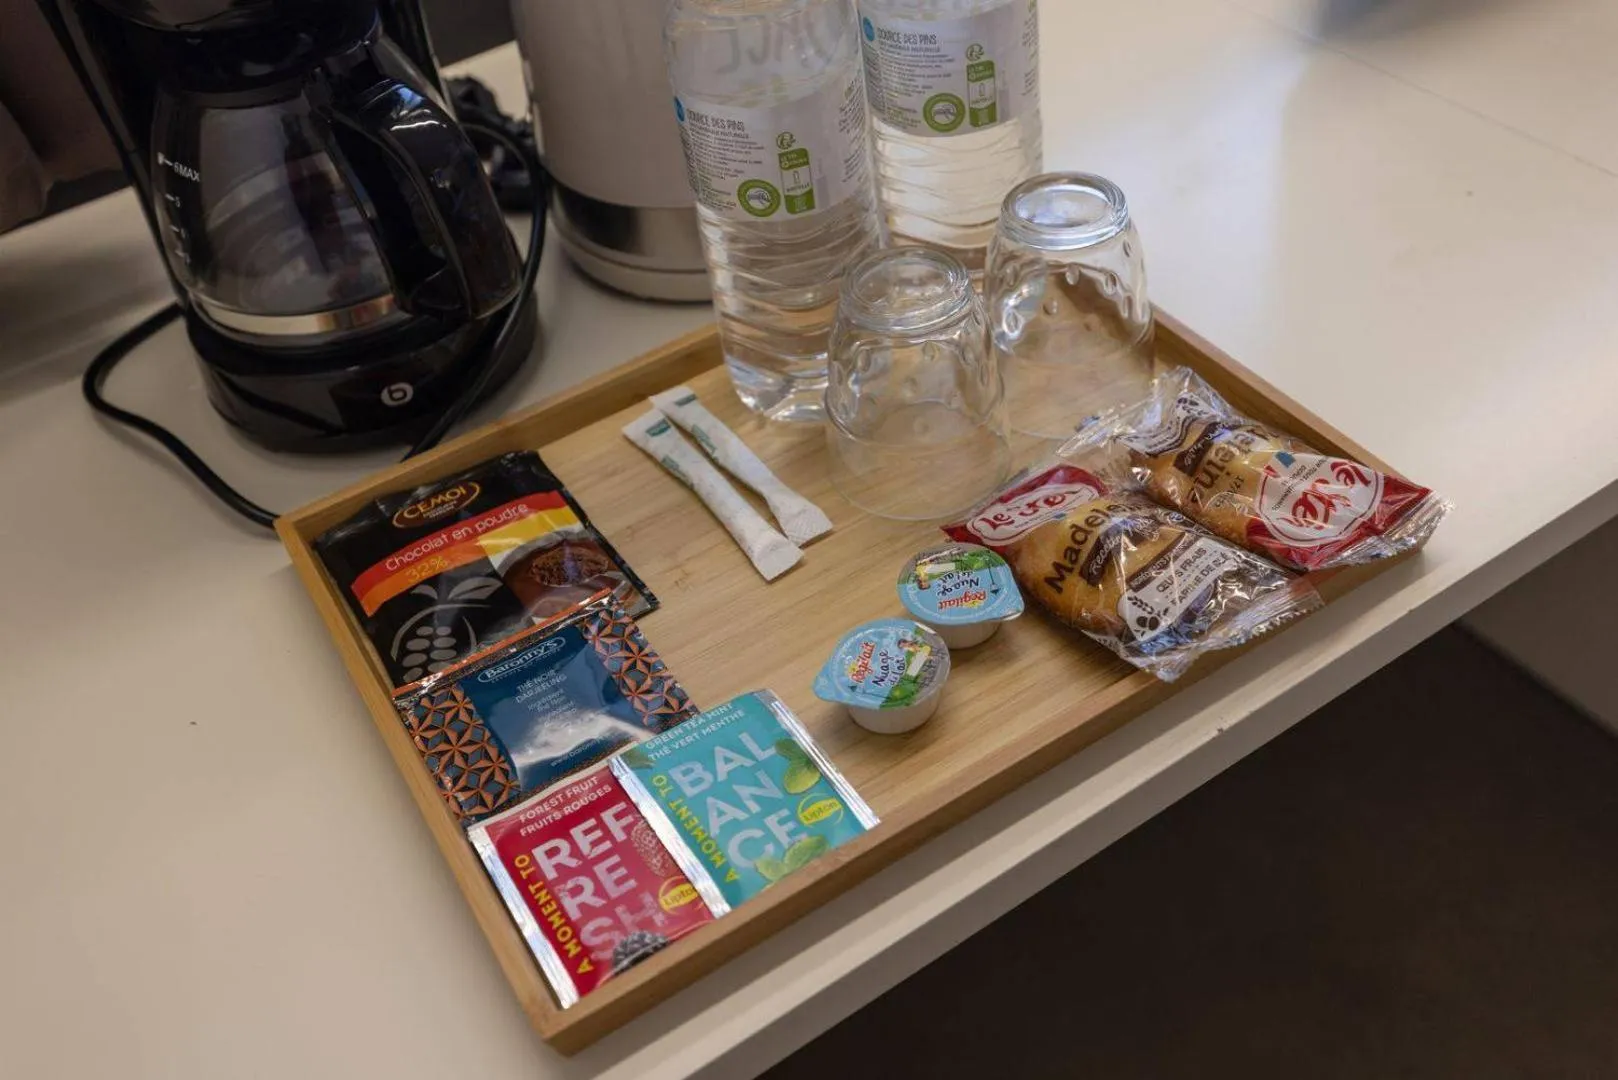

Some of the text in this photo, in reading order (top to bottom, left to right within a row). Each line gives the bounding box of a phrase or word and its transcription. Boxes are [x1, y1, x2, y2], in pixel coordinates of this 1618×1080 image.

[385, 533, 450, 571] Chocolat
[452, 522, 473, 541] en
[475, 502, 529, 534] poudre
[1180, 547, 1207, 571] FRAIS
[404, 556, 448, 583] 32%
[937, 577, 979, 596] Nuage
[1200, 564, 1217, 577] DE
[872, 650, 893, 686] Nuage
[645, 703, 733, 749] GREEN TEA MINT
[671, 733, 701, 750] VERT
[701, 709, 745, 736] MENTHE
[668, 732, 777, 798] BAL
[519, 776, 599, 824] FOREST FRUIT
[520, 785, 612, 837] FRUITS ROUGES
[706, 768, 784, 837] AN
[803, 800, 838, 822] Lipton
[531, 801, 635, 880] REF
[651, 775, 740, 884] A MOMENT TO
[727, 808, 807, 868] CE
[558, 854, 637, 921] RE
[514, 854, 594, 974] A MOMENT TO
[579, 893, 669, 961] SH
